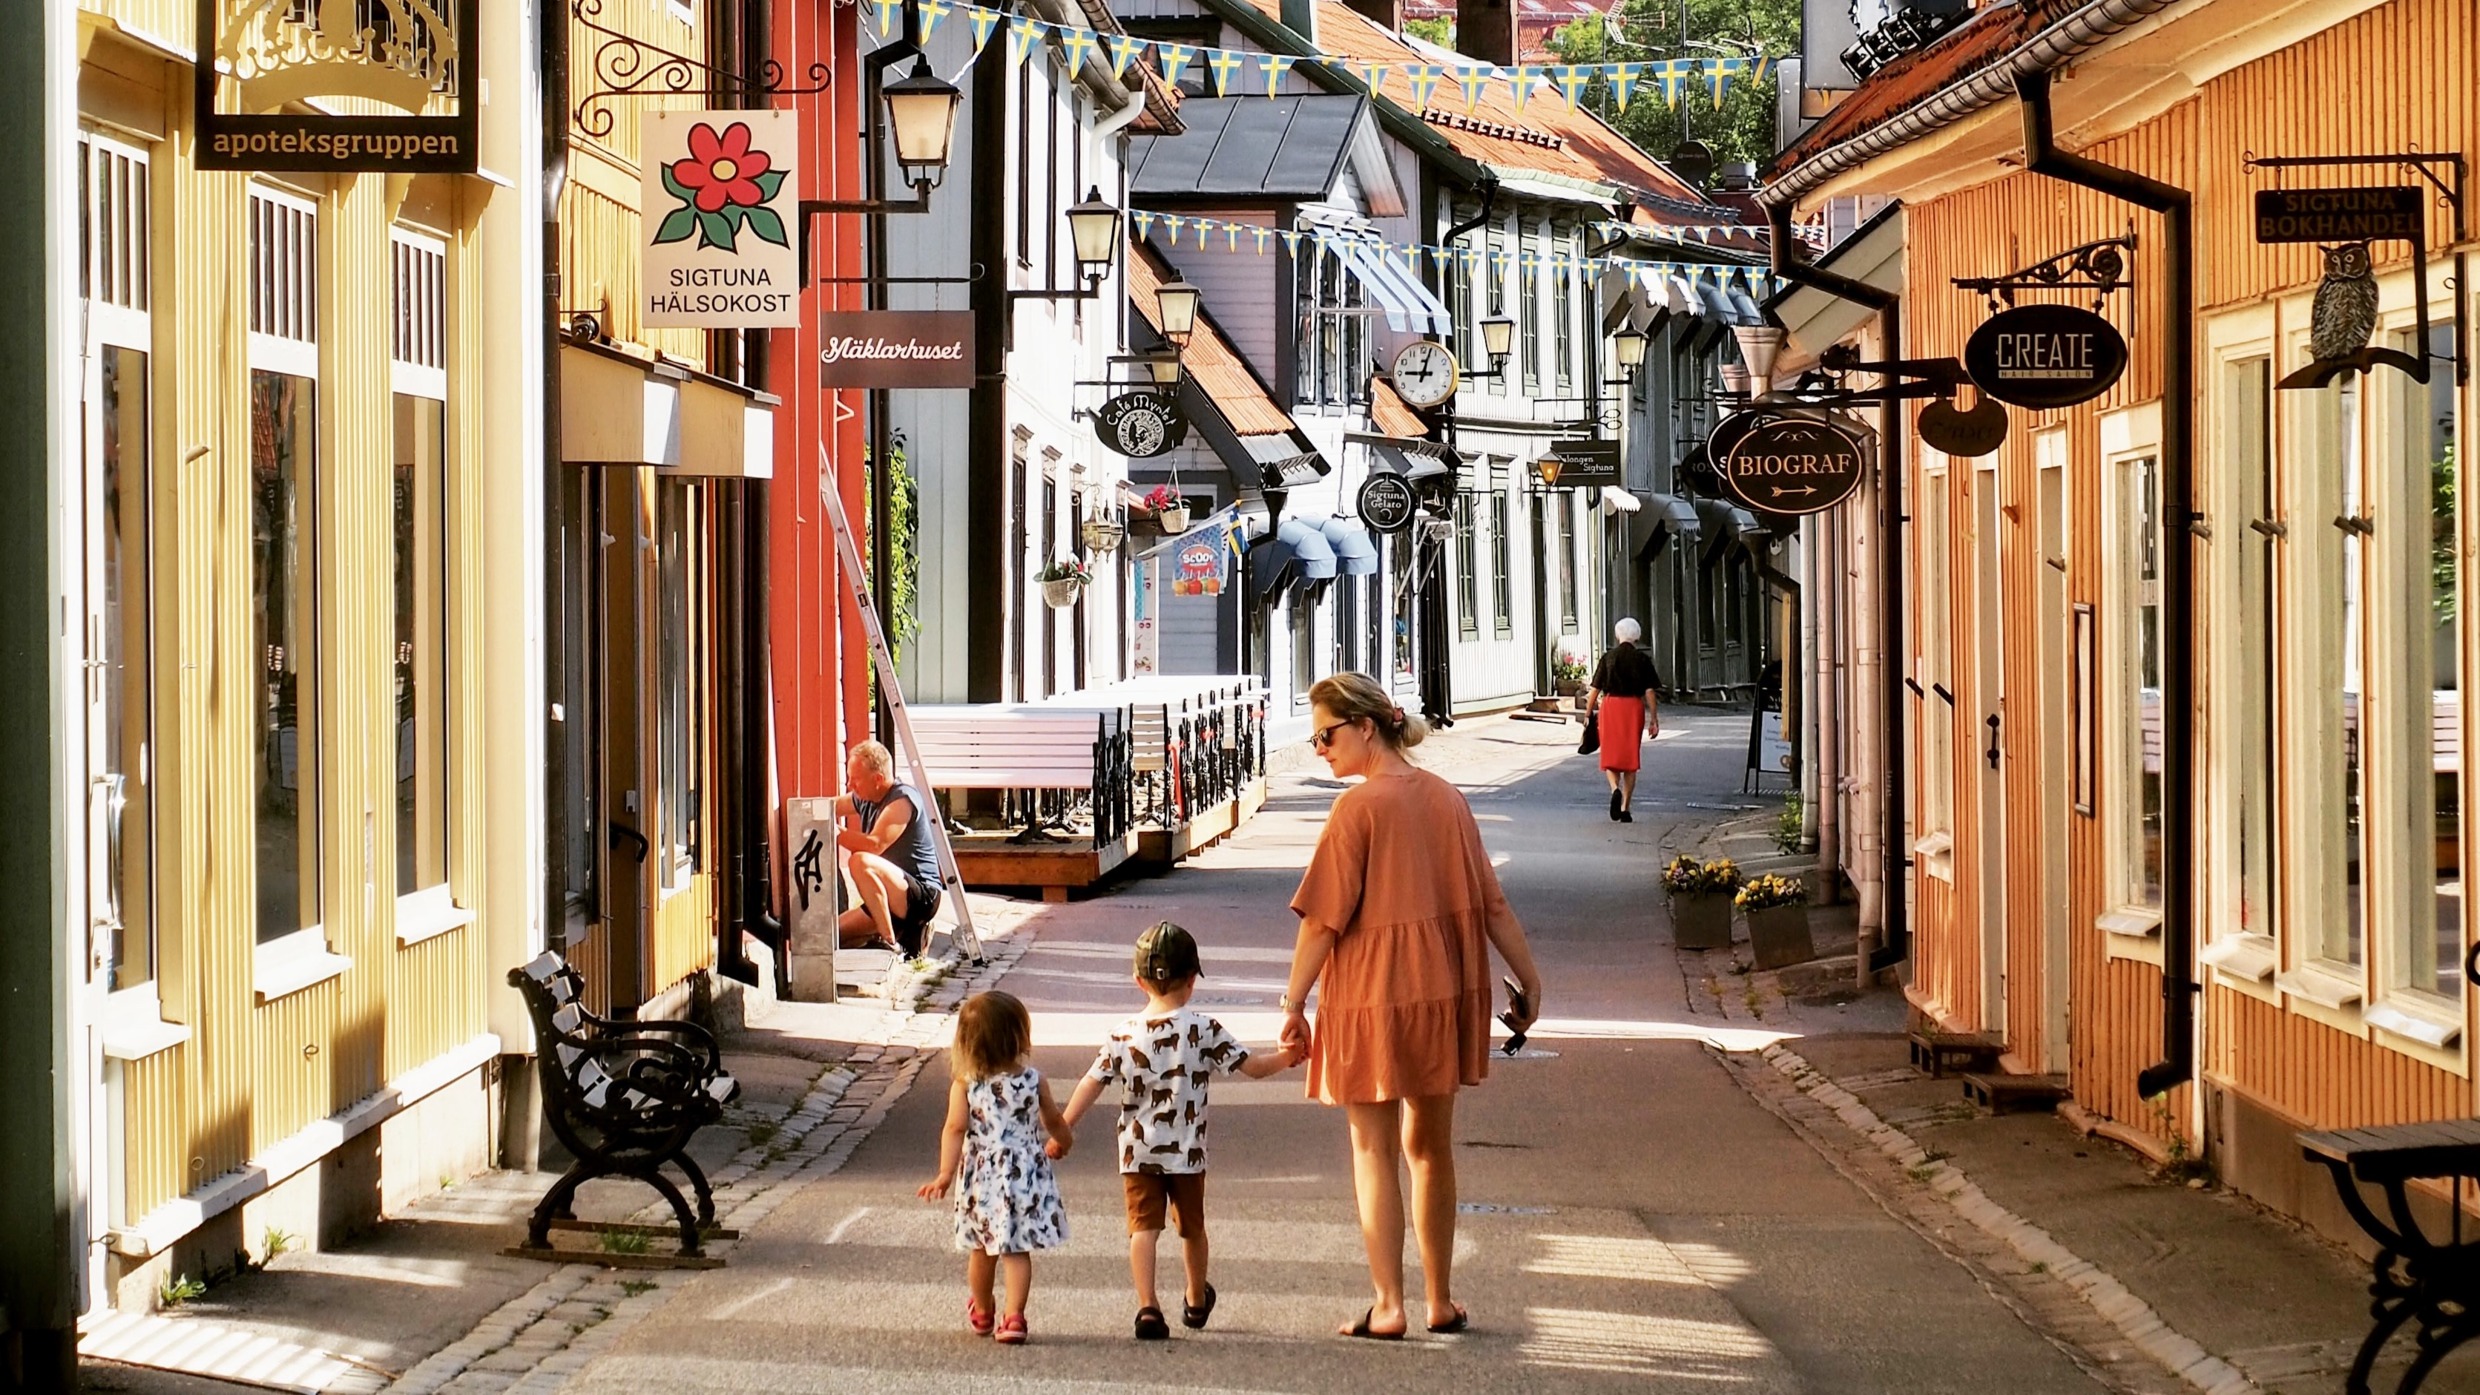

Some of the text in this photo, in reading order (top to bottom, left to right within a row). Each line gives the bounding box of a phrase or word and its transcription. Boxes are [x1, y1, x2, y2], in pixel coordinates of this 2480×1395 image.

[213, 128, 458, 159] apoteksgruppen
[2286, 192, 2396, 212] SIGTUNA
[2260, 213, 2420, 237] BOKHANDEL
[669, 267, 772, 288] SIGTUNA
[651, 291, 791, 312] HÄLSOKOST
[820, 336, 963, 363] Mäklarhuset
[1998, 333, 2094, 368] CREATE
[1106, 399, 1132, 426] Café
[1583, 463, 1615, 473] Sigtuna
[1738, 453, 1852, 476] BIOGRAF
[1367, 490, 1405, 503] Sigtuna
[1370, 499, 1402, 508] Gelato
